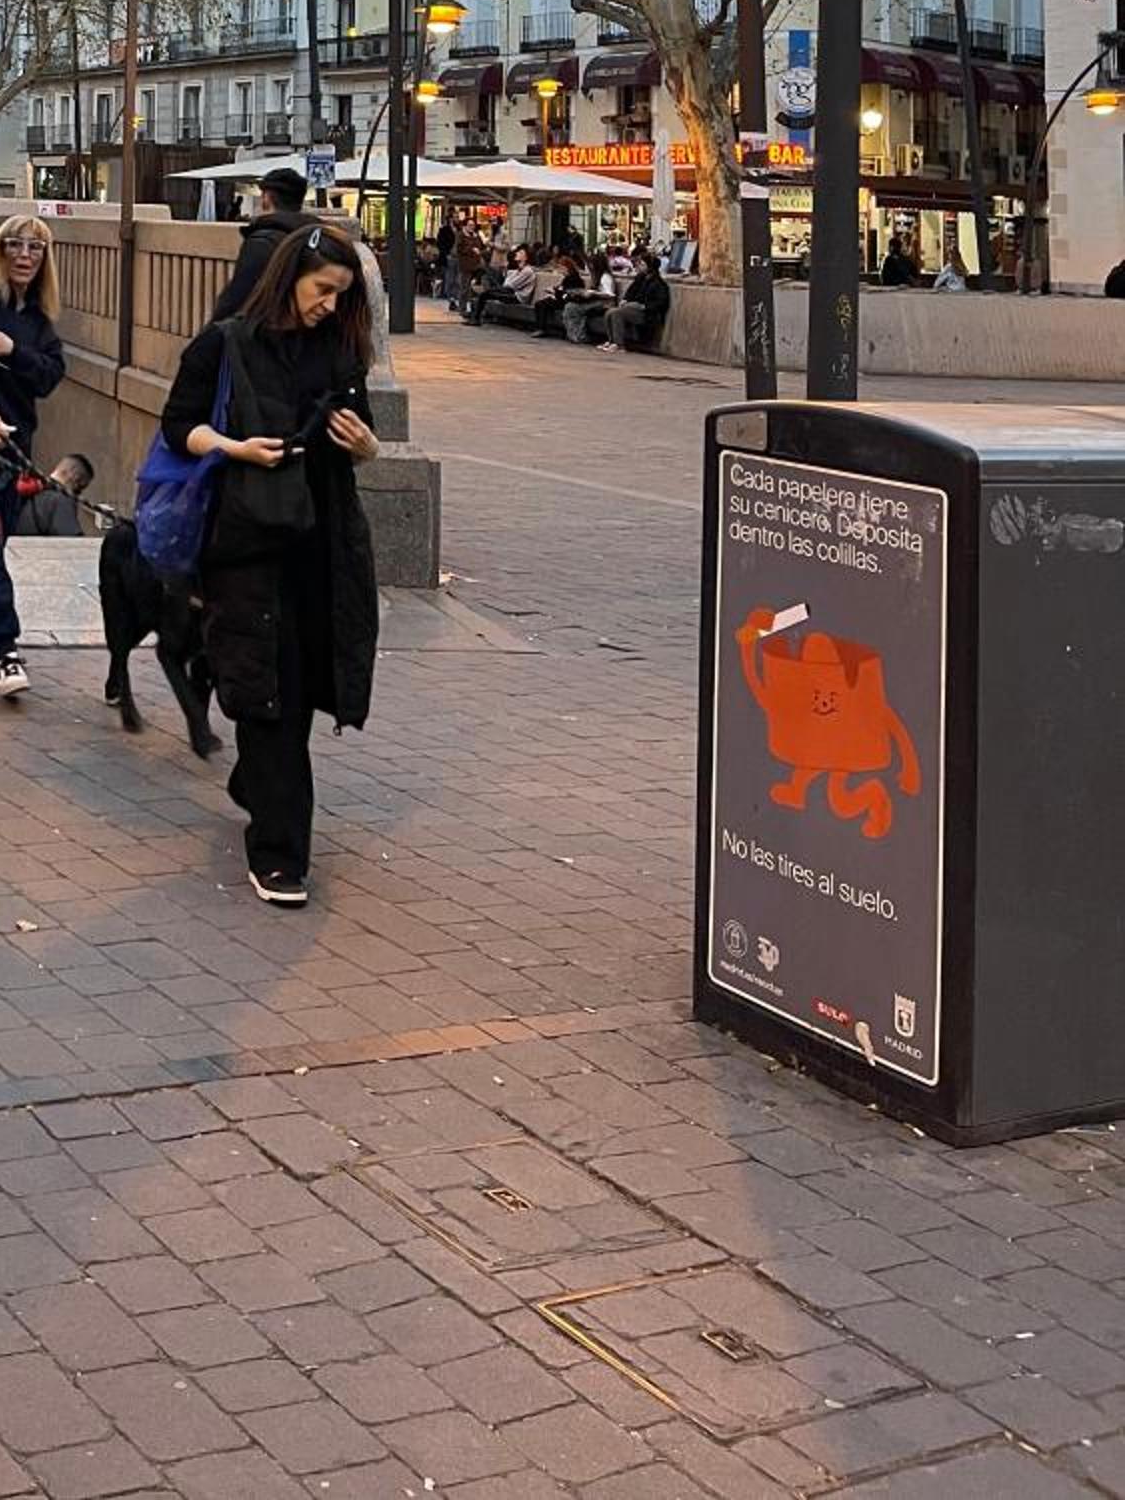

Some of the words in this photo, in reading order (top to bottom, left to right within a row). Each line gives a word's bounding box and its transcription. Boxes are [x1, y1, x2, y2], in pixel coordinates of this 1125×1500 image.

[545, 146, 651, 166] RESTAURANTE
[768, 144, 805, 165] BAR
[729, 462, 775, 493] Cada
[777, 477, 856, 510] papelera
[859, 490, 909, 520] tiene
[729, 495, 750, 515] su
[753, 500, 833, 533] cenicero.
[836, 512, 924, 553] Deposita
[729, 519, 786, 550] dentro
[788, 530, 814, 557] las
[816, 542, 883, 574] colillas.
[721, 828, 748, 859] No
[750, 840, 775, 871] las
[777, 853, 815, 889] tires
[818, 872, 835, 896] al
[838, 882, 899, 922] suelo.
